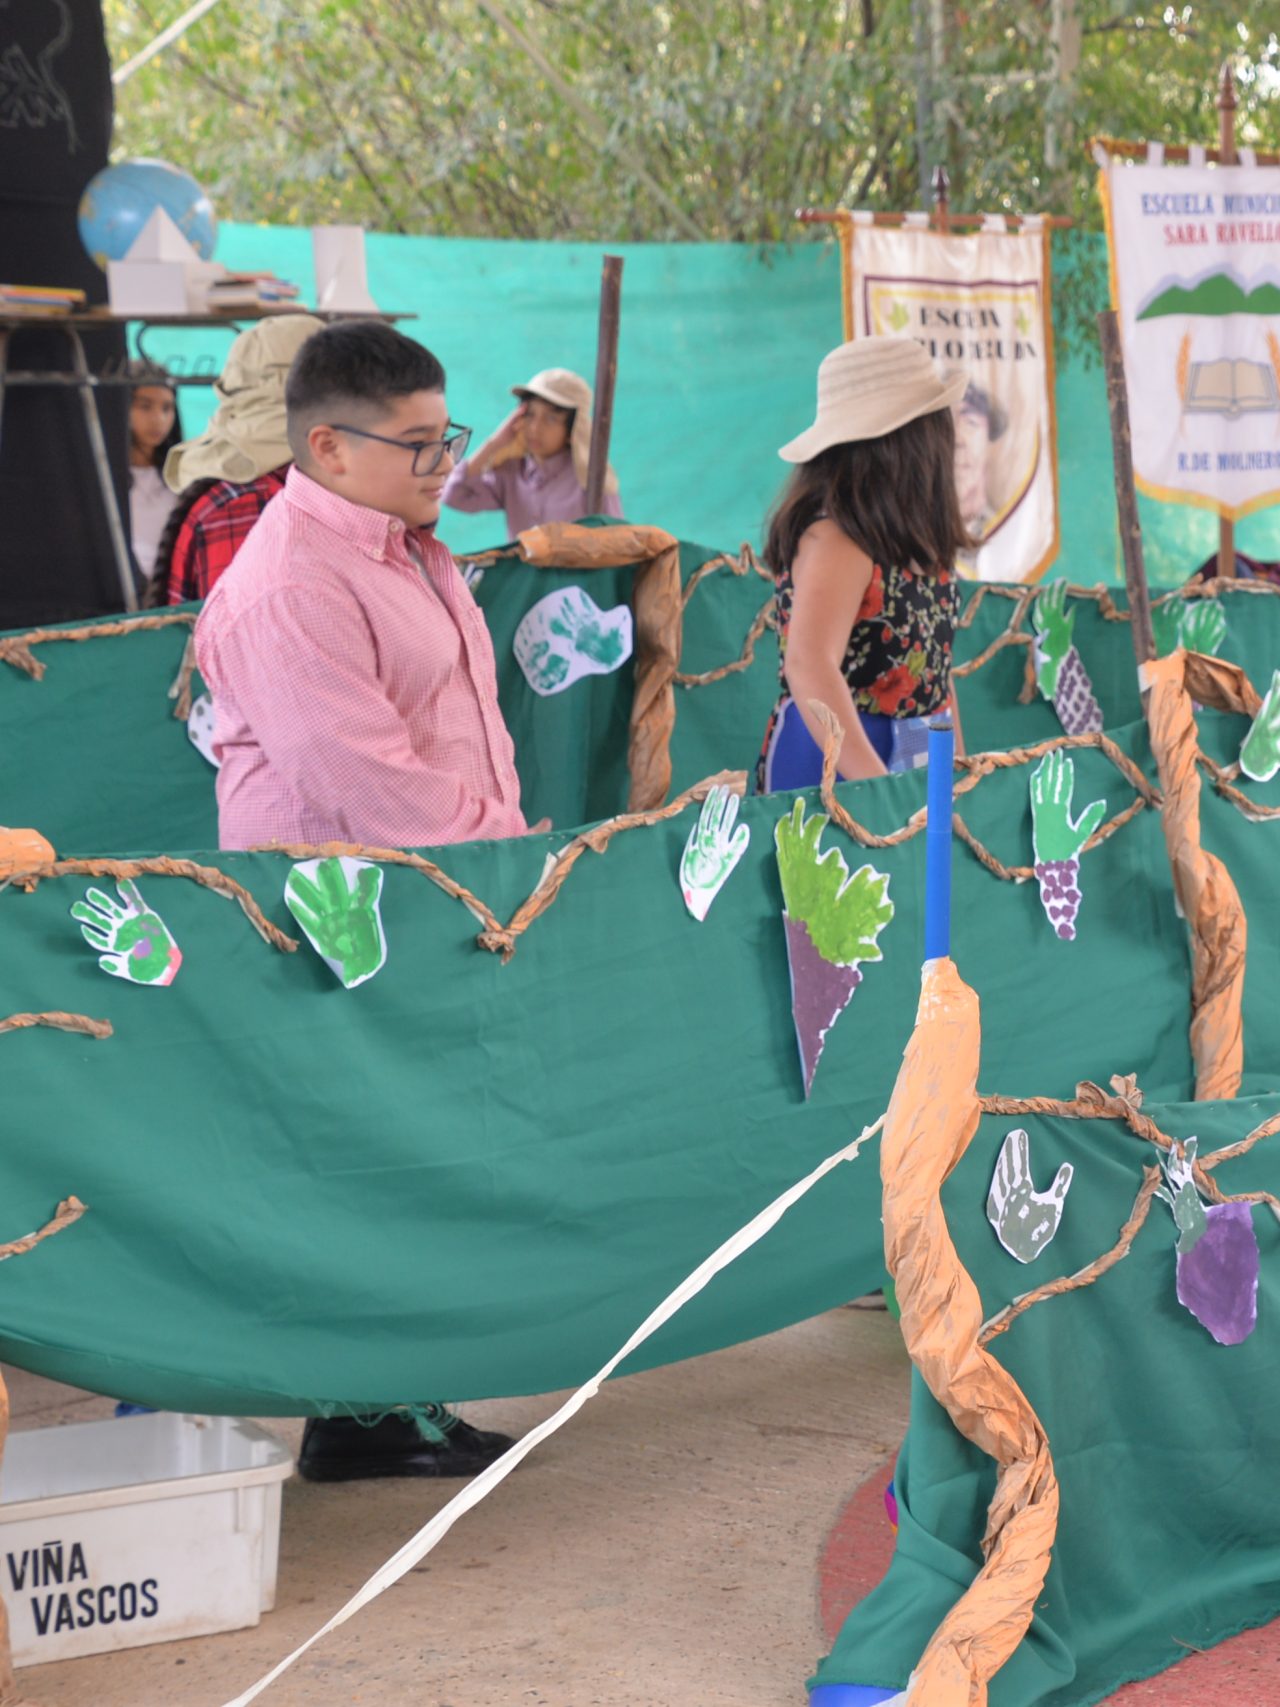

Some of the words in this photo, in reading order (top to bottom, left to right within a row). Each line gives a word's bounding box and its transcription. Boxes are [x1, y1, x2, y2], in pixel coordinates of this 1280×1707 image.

[1141, 194, 1214, 216] ESCUELA
[1164, 224, 1208, 246] SARA
[6, 1540, 89, 1592] VIÑA
[30, 1578, 160, 1637] VASCOS
